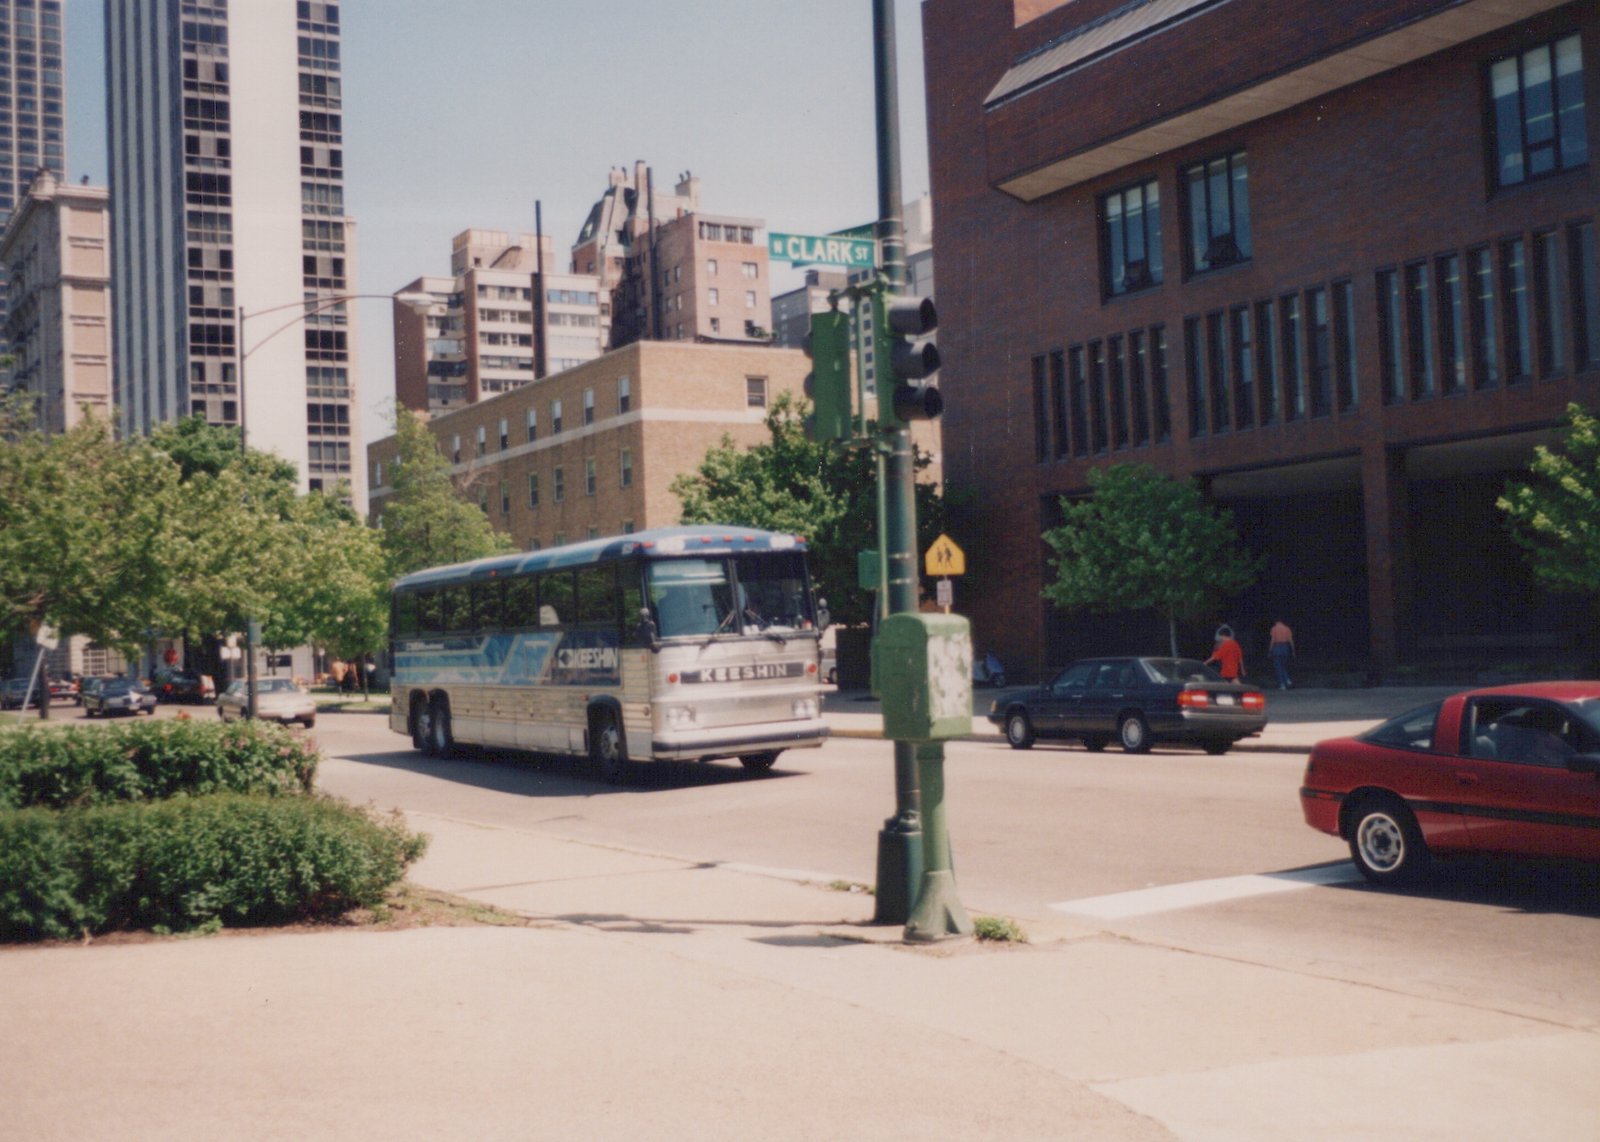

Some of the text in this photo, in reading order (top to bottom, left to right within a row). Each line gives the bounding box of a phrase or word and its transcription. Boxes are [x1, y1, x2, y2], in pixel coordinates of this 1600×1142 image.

[787, 237, 854, 263] CLARK
[855, 246, 868, 260] ST
[700, 663, 788, 682] KEESHIN
